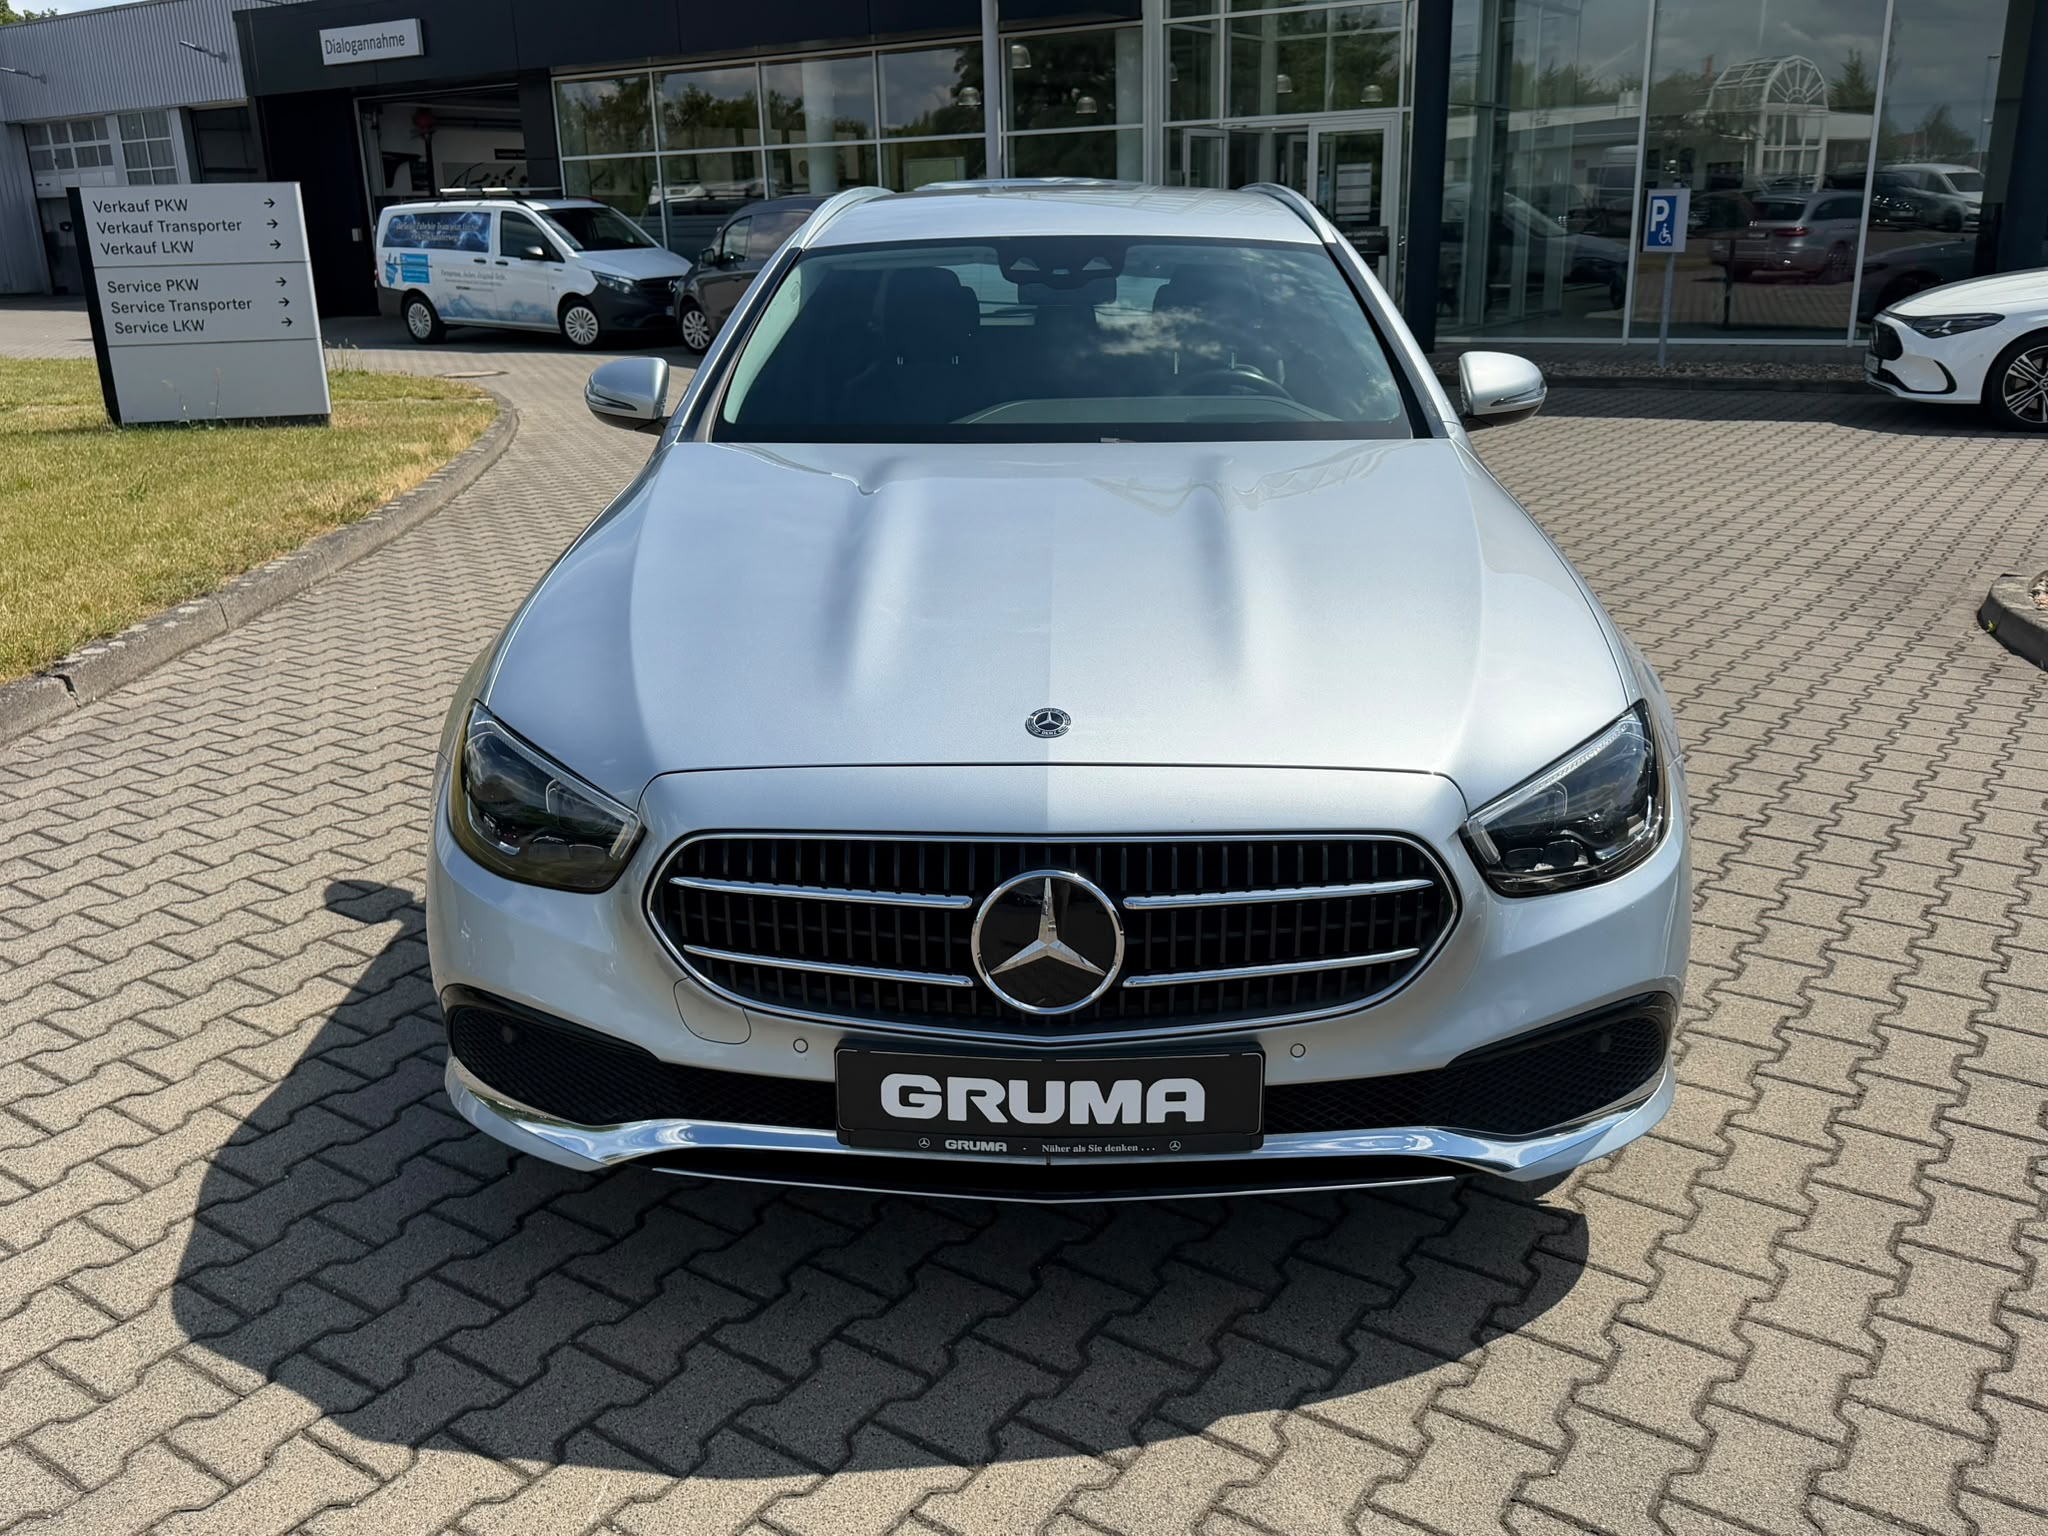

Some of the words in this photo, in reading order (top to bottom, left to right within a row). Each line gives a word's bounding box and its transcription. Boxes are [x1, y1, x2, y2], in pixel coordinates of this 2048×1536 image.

[325, 33, 405, 55] Dialogannahme
[93, 199, 150, 213] Verkauf
[154, 198, 188, 212] PKW
[1650, 199, 1670, 232] P
[96, 220, 154, 234] Verkauf
[157, 219, 242, 235] Transporter
[100, 241, 157, 255] Verkauf
[162, 240, 194, 254] LKW
[107, 280, 162, 293] Service
[166, 278, 199, 292] PKW
[111, 300, 165, 314] Service
[168, 298, 252, 313] Transporter
[114, 321, 169, 334] Service
[173, 319, 205, 333] LKW
[881, 1073, 1206, 1125] GRUMA
[945, 1139, 1007, 1152] GRUMA
[1042, 1144, 1072, 1153] Näher
[1073, 1144, 1086, 1153] als
[1088, 1144, 1103, 1153] Sie
[1104, 1143, 1138, 1153] denken
